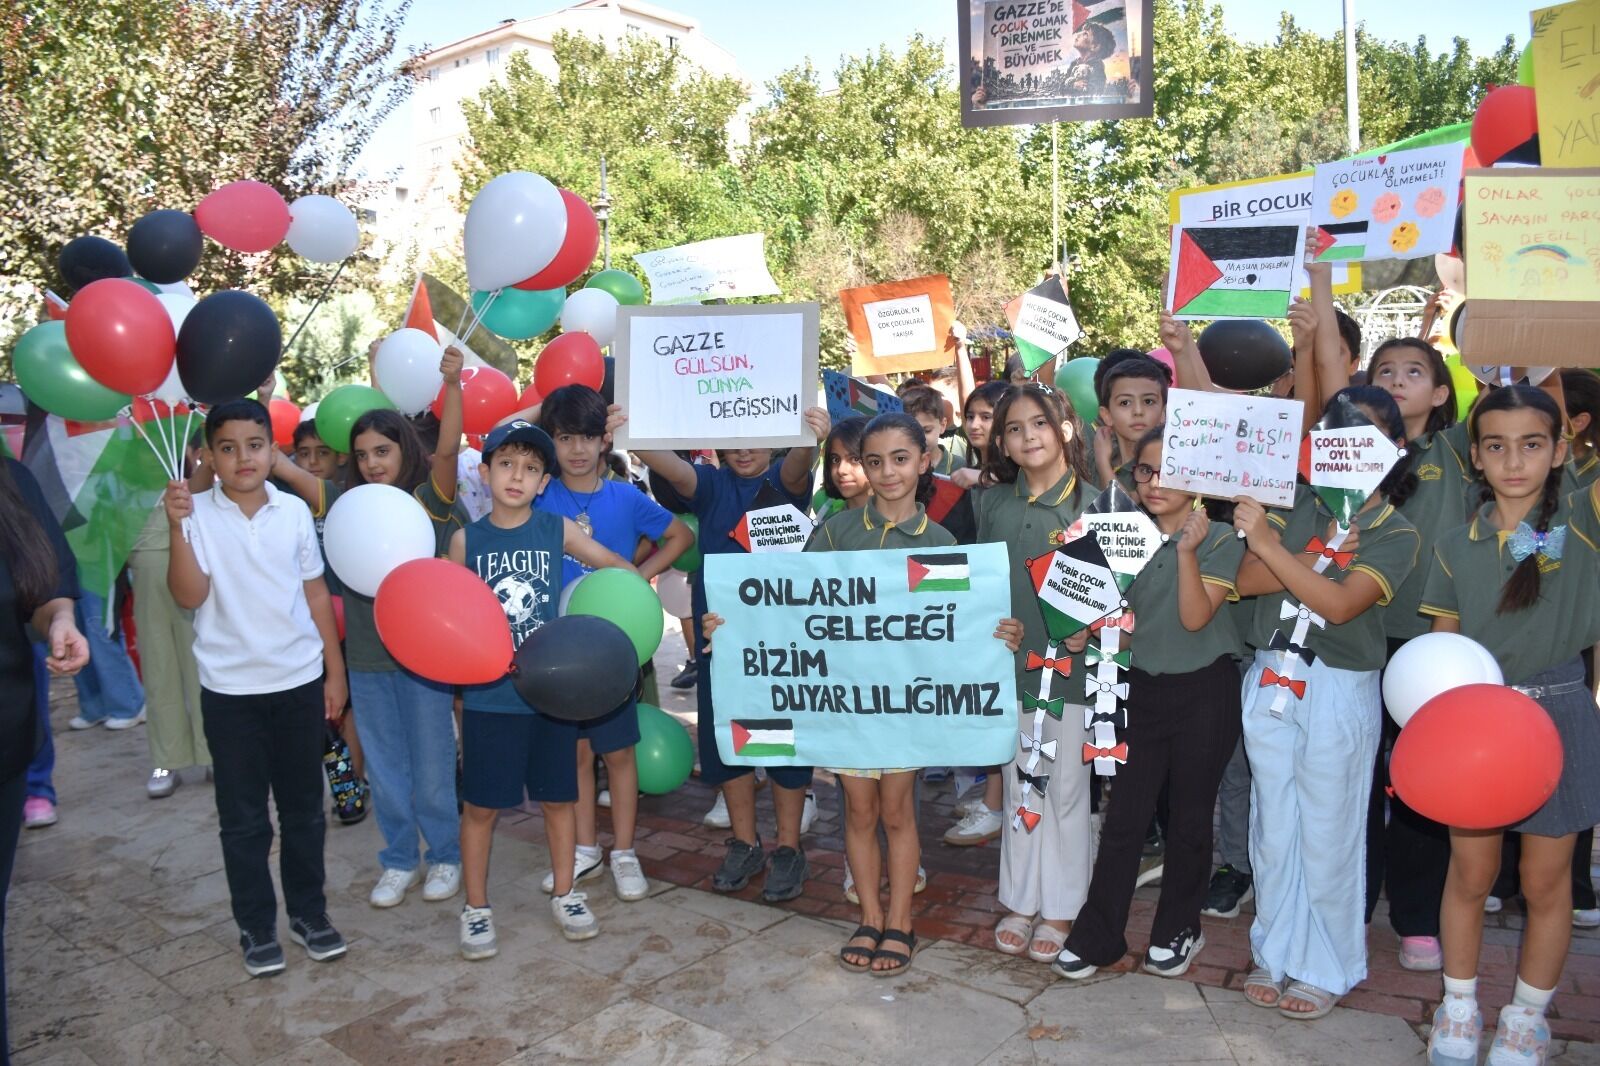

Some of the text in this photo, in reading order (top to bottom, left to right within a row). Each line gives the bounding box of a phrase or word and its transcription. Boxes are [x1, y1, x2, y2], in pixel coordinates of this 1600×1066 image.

[994, 0, 1064, 21] GAZZE'DE
[990, 14, 1068, 38] ÇOCUK OLMAK
[1000, 28, 1062, 47] DİRENMEK
[1024, 43, 1036, 52] VE
[1004, 50, 1062, 69] BÜYÜMEK
[1332, 166, 1395, 188] ÇOCUKLAR
[1478, 187, 1543, 200] ONLAR
[1212, 200, 1241, 219] BİR
[1225, 262, 1259, 272] MASUM
[653, 332, 725, 356] GAZZE
[675, 353, 754, 376] GÜLSÜN,
[698, 377, 753, 395] DÜNYA
[710, 394, 798, 419] DEĞİŞSİN!
[749, 524, 801, 537] GÜVEN İÇİNDE
[751, 514, 793, 527] ÇOCUKLAR
[757, 534, 805, 546] BÜYÜMELİDİR!
[1115, 534, 1146, 548] İÇİNDE
[476, 550, 550, 587] LEAGUE
[1054, 559, 1107, 589] HİÇBİR ÇOCUK
[738, 577, 876, 607] ONLARIN
[1047, 578, 1108, 612] BIRAKILMAMALIDIR!
[1061, 577, 1091, 596] GERİDE
[804, 603, 956, 642] GELECEĞİ
[743, 640, 828, 677] BİZİM
